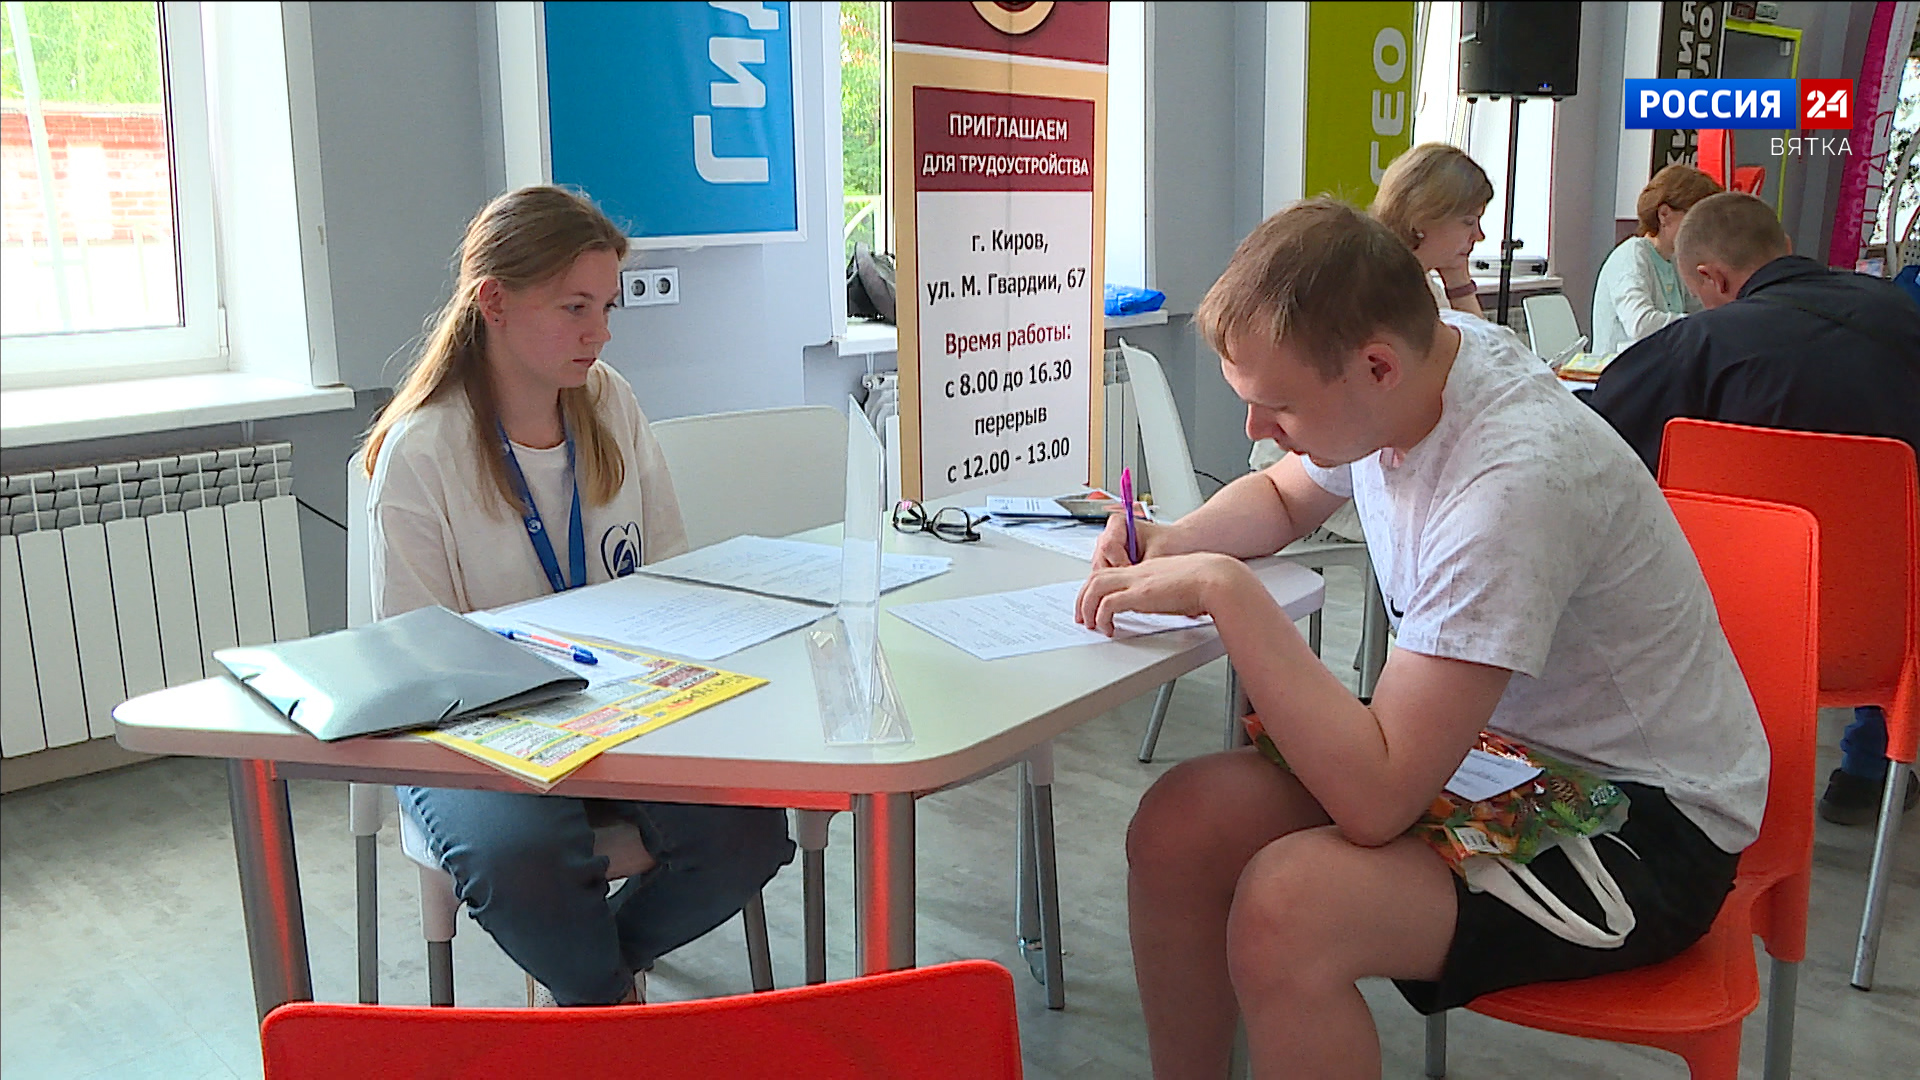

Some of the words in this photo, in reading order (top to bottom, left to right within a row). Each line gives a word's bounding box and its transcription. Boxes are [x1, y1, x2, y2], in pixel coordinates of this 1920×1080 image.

[949, 113, 1068, 141] ПРИГЛАШАЕМ
[922, 153, 956, 176] ДЛЯ
[960, 152, 1089, 176] ТРУДОУСТРОЙСТВА
[971, 234, 985, 252] г.
[991, 229, 1049, 255] Киров,
[926, 280, 955, 305] ул.
[961, 275, 981, 297] М.
[987, 272, 1063, 297] Гвардии,
[1066, 267, 1086, 288] 67
[945, 332, 1001, 359] Время
[1007, 323, 1072, 352] работы:
[945, 380, 955, 398] с
[960, 370, 998, 396] 8.00
[1002, 371, 1023, 393] до
[1029, 359, 1072, 385] 16.30
[974, 406, 1048, 437] перерыв
[947, 465, 957, 483] с
[963, 449, 1010, 480] 12.00
[1027, 437, 1070, 465] 13.00
